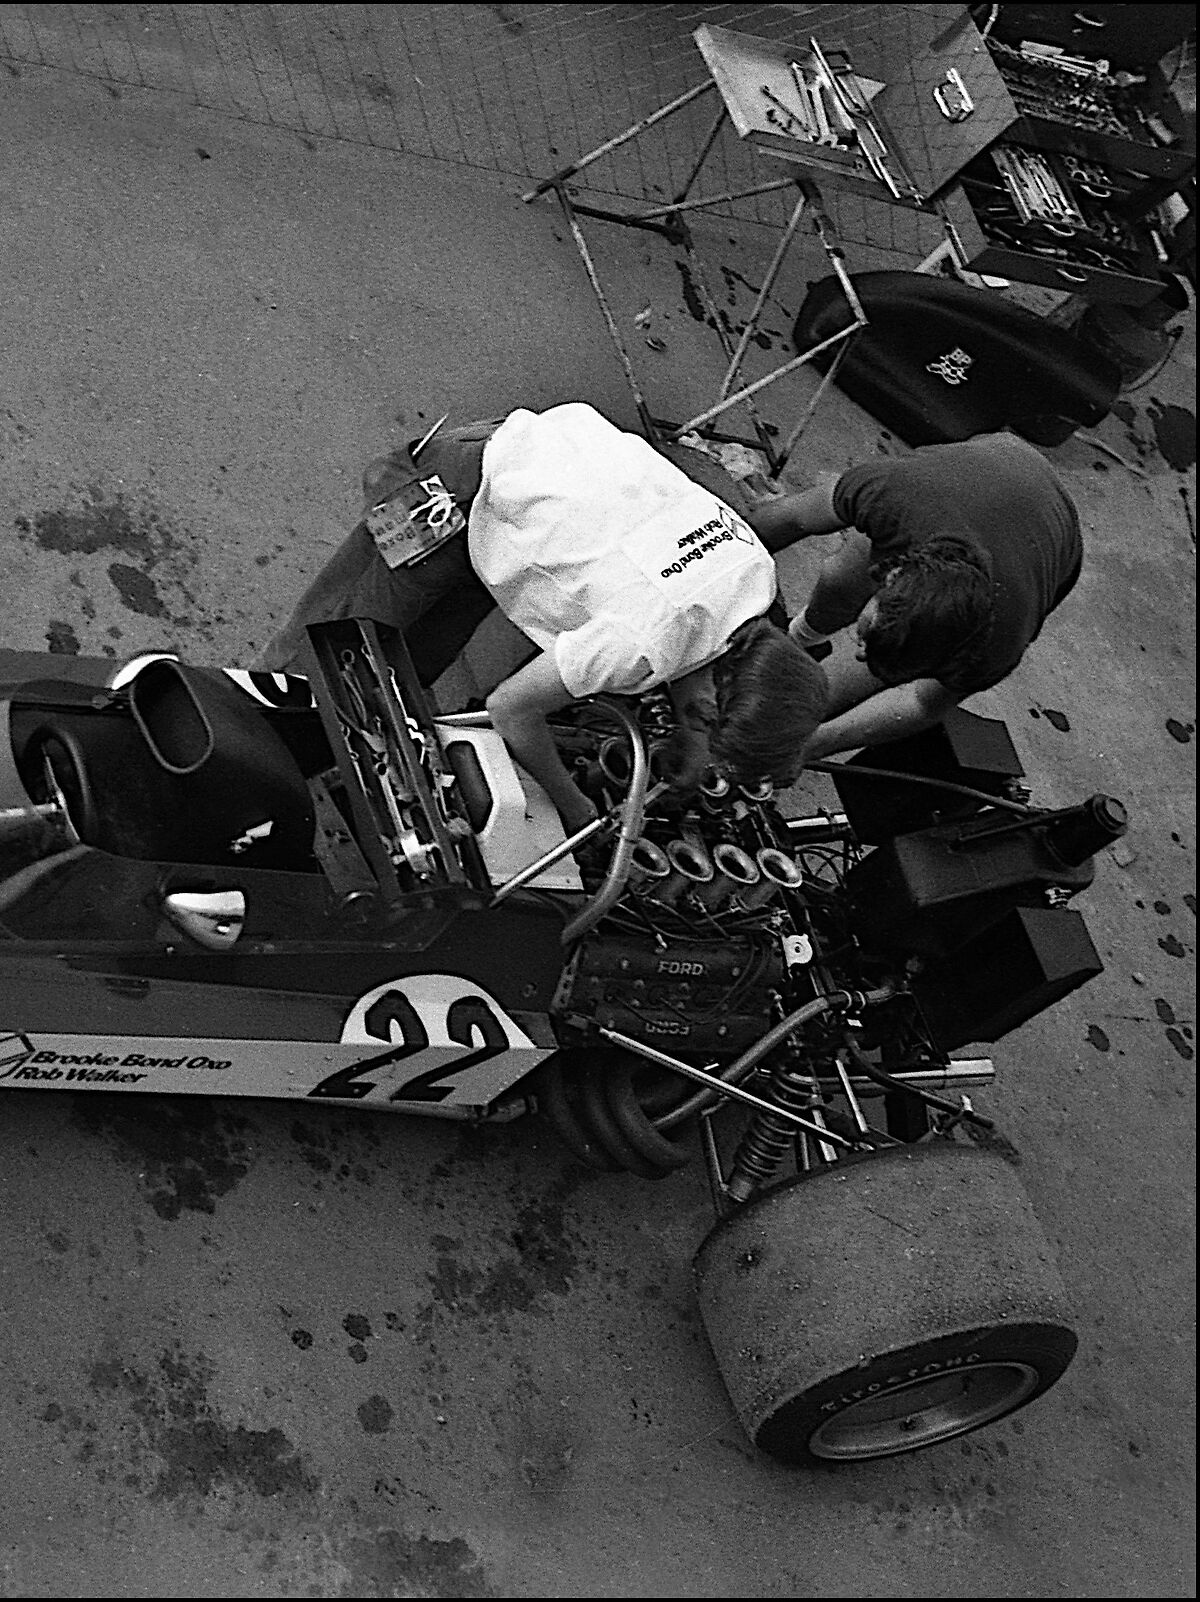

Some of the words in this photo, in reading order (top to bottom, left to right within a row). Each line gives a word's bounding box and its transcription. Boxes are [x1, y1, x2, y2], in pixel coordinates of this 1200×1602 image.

[700, 530, 734, 553] Brooke
[679, 547, 703, 569] Bond
[660, 562, 683, 578] Oxo
[657, 960, 704, 976] FORD
[306, 988, 511, 1103] 22
[30, 1050, 120, 1066] Brooke
[120, 1053, 189, 1069] Bond
[185, 1055, 233, 1070] Oxo
[13, 1066, 64, 1081] Rob
[65, 1068, 148, 1083] Walker
